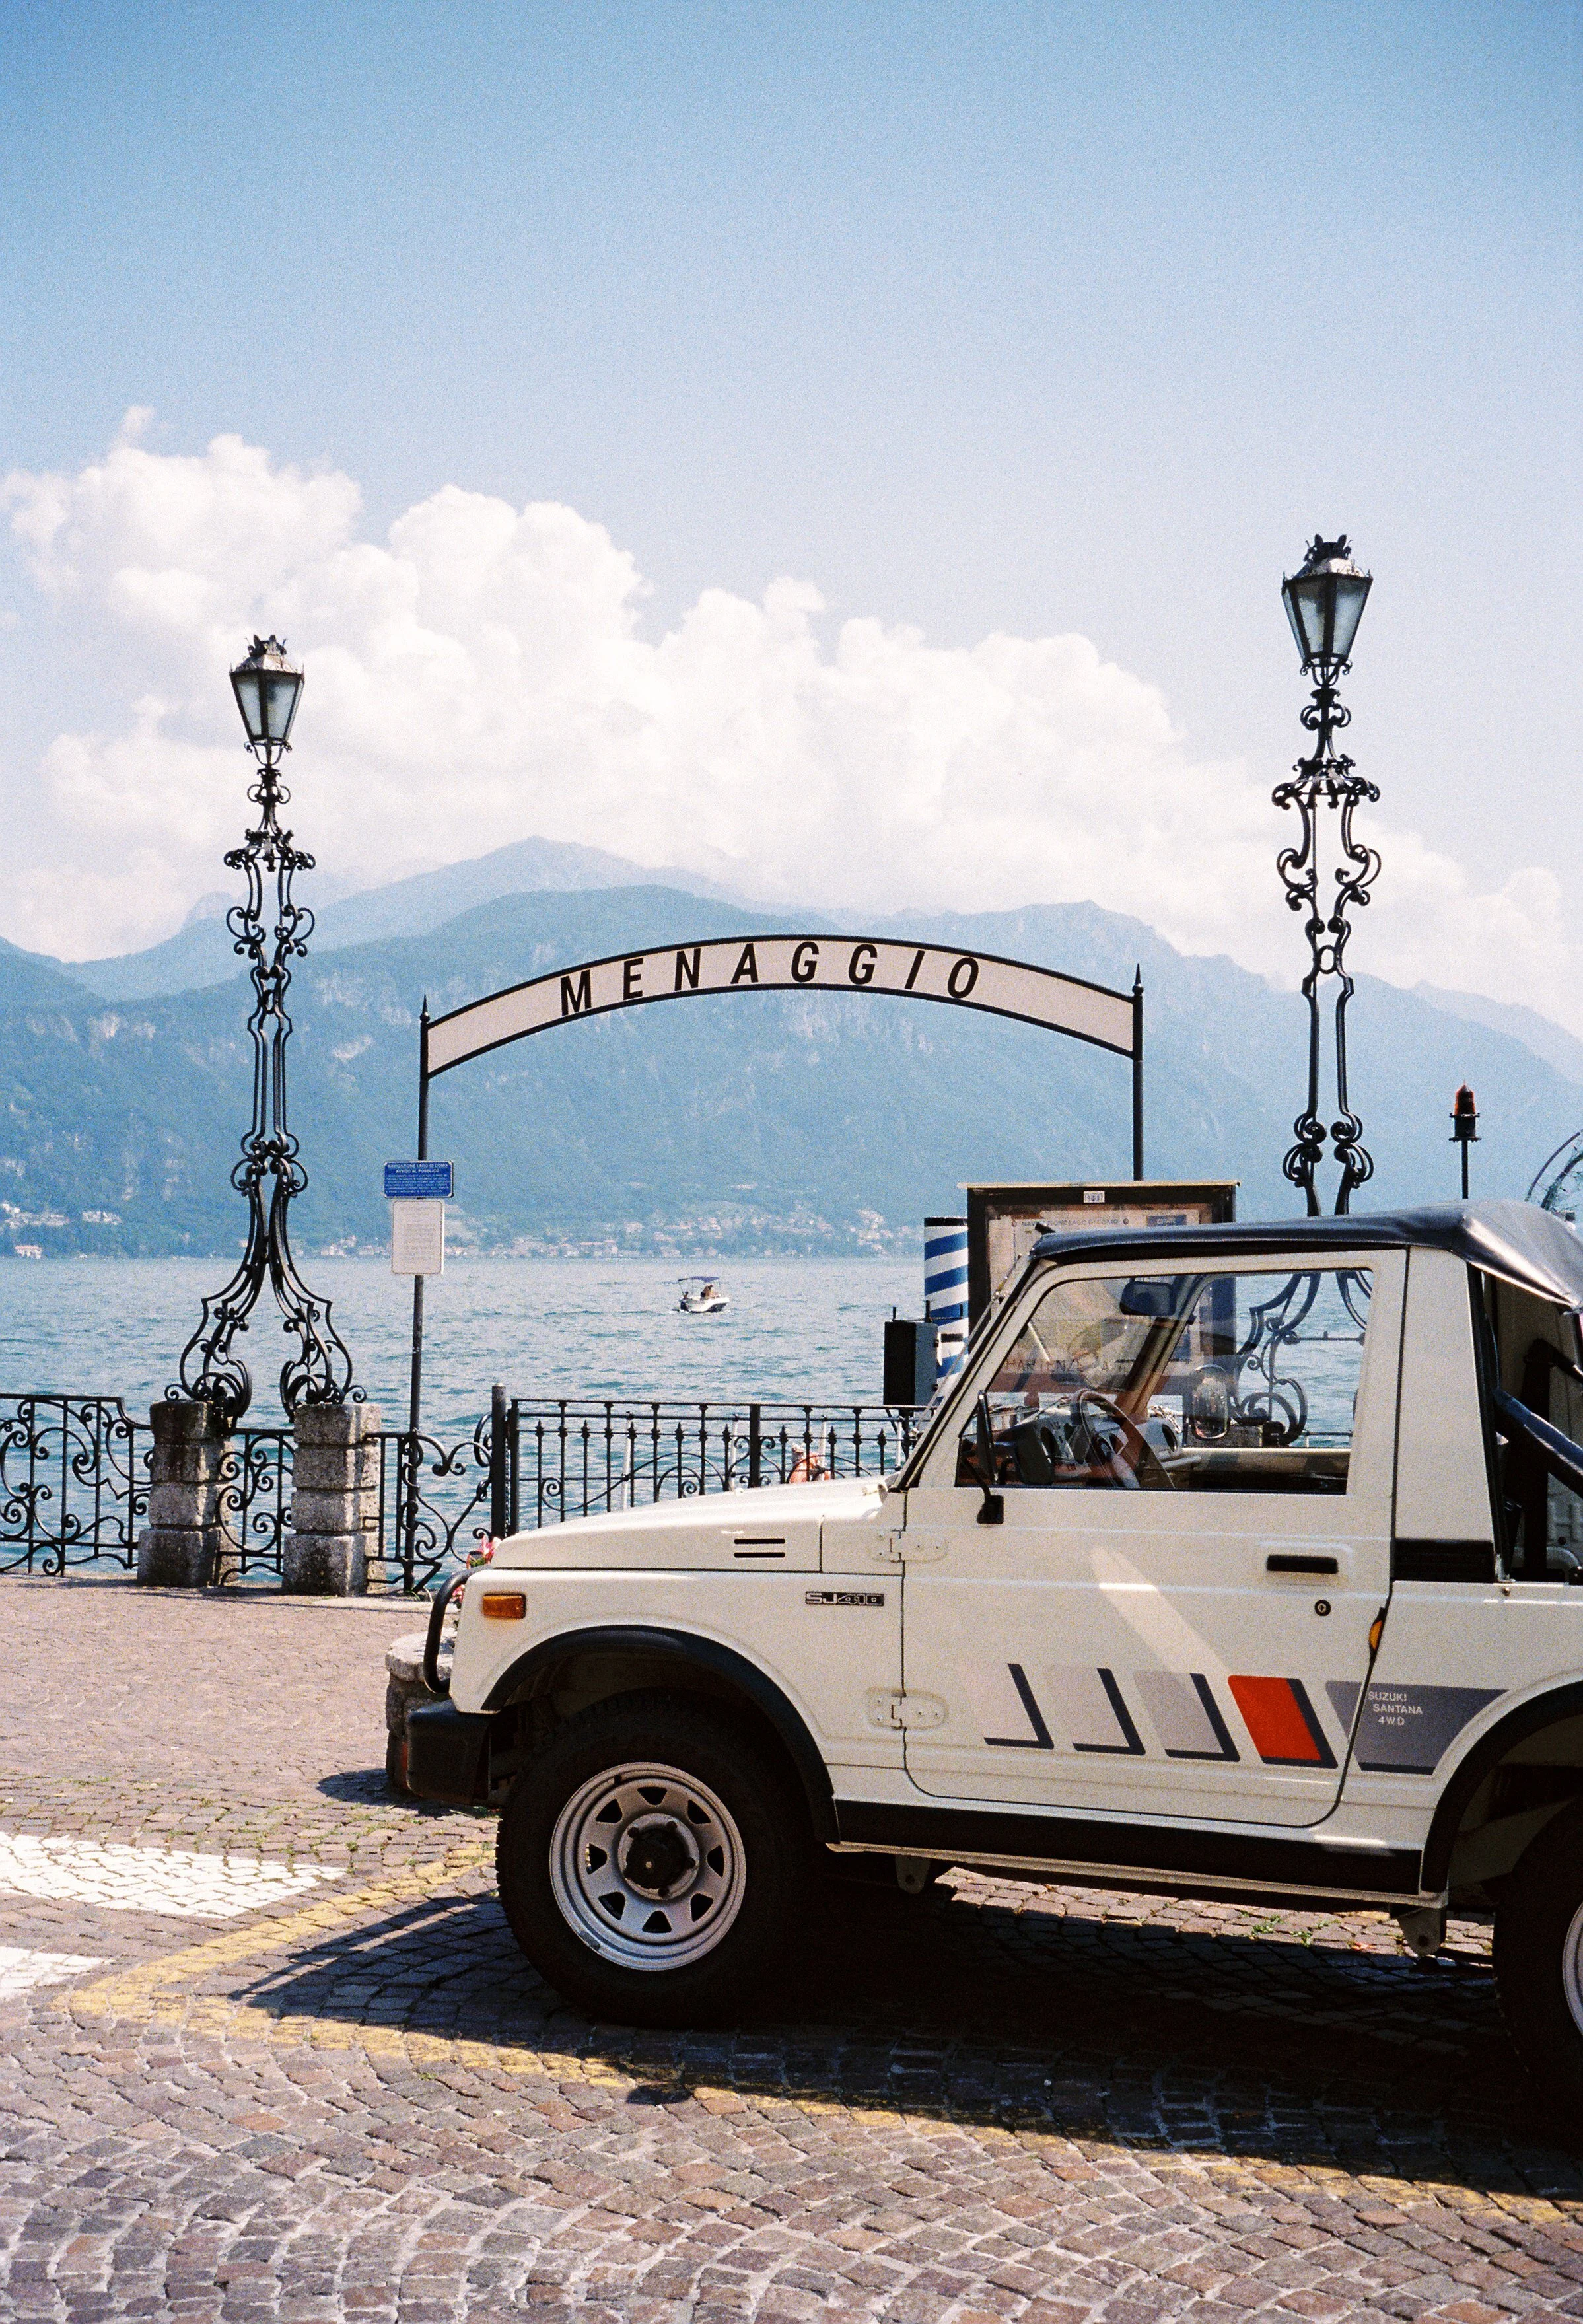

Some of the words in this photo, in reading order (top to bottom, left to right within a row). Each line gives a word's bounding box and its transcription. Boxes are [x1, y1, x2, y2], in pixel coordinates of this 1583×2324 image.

[559, 941, 979, 1016] MENAGGIO
[806, 1592, 883, 1605] SJ410
[1368, 1691, 1407, 1702] SUZUKI
[1373, 1703, 1423, 1715] SANTANA
[1378, 1716, 1405, 1726] 4WD
